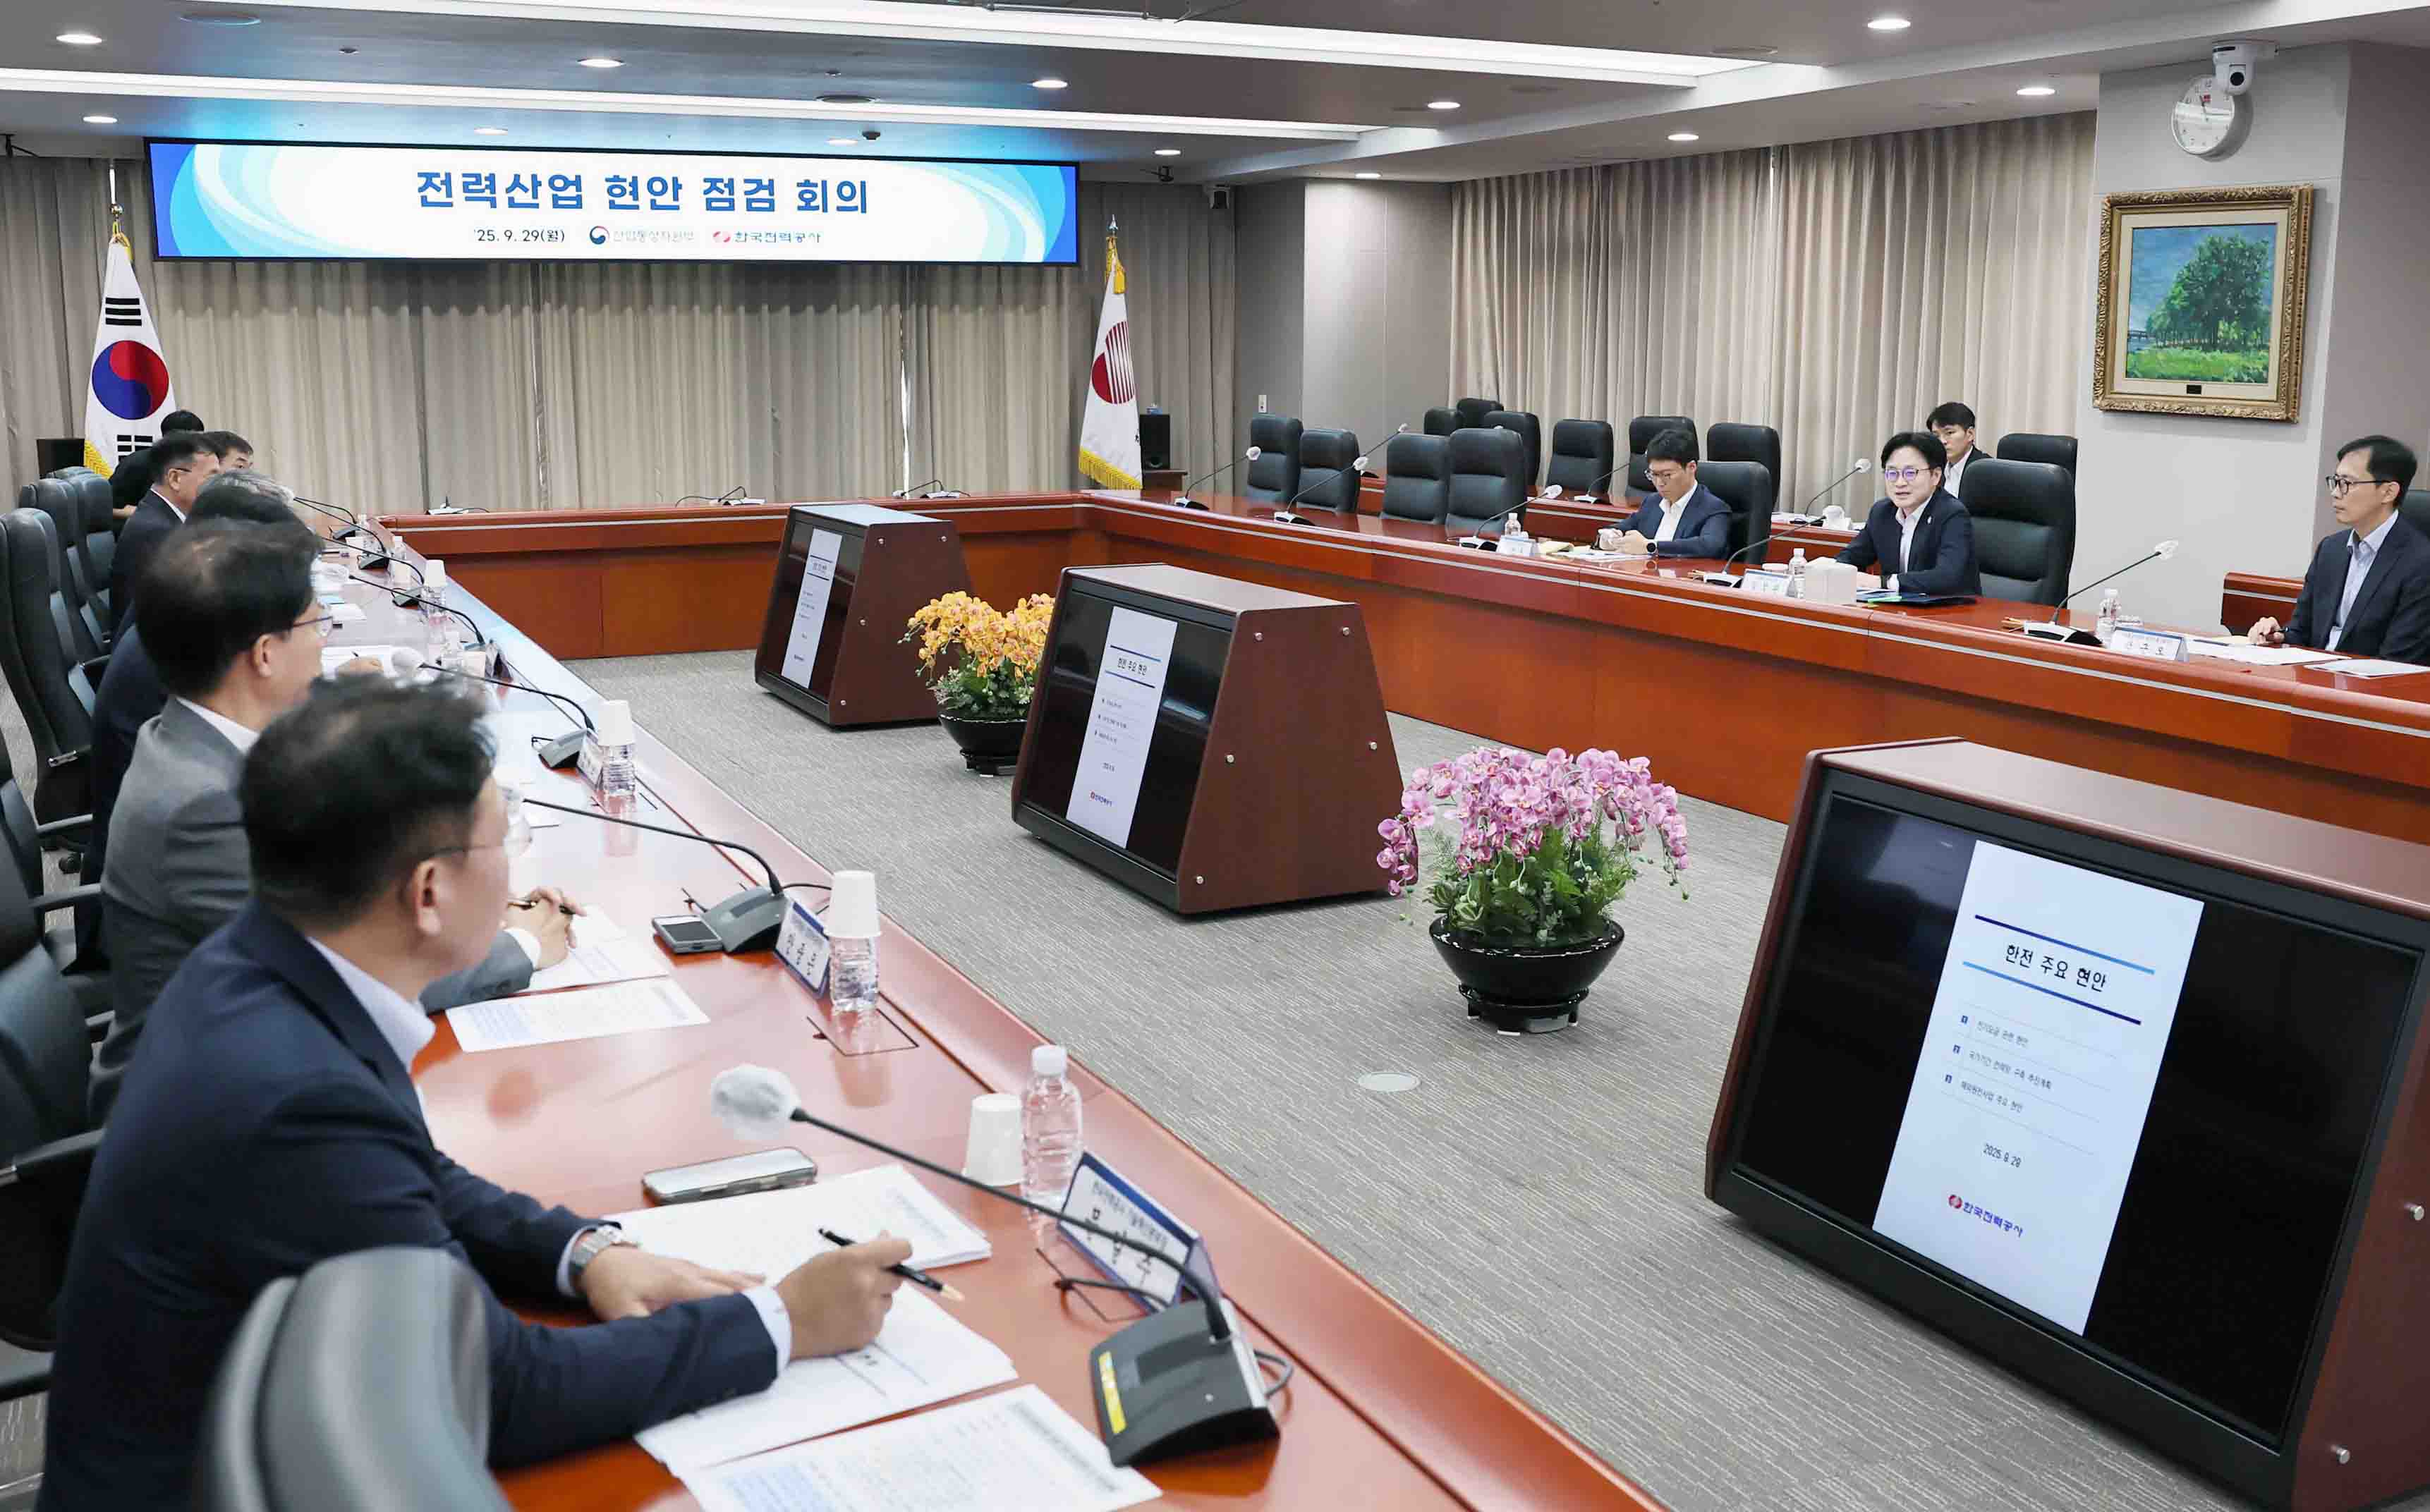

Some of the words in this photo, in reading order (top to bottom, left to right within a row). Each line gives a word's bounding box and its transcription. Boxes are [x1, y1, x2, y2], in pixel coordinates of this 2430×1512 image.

[417, 171, 583, 209] 전력산업
[605, 174, 683, 211] 현안
[703, 177, 776, 212] 점검
[796, 178, 867, 214] 회의
[522, 228, 565, 243] 29(월)
[734, 230, 822, 243] 한국전력공사
[2005, 943, 2034, 969] 한전
[2040, 954, 2069, 980] 주요
[2076, 966, 2108, 992] 현안
[1963, 1201, 2023, 1238] 한국전력공사
